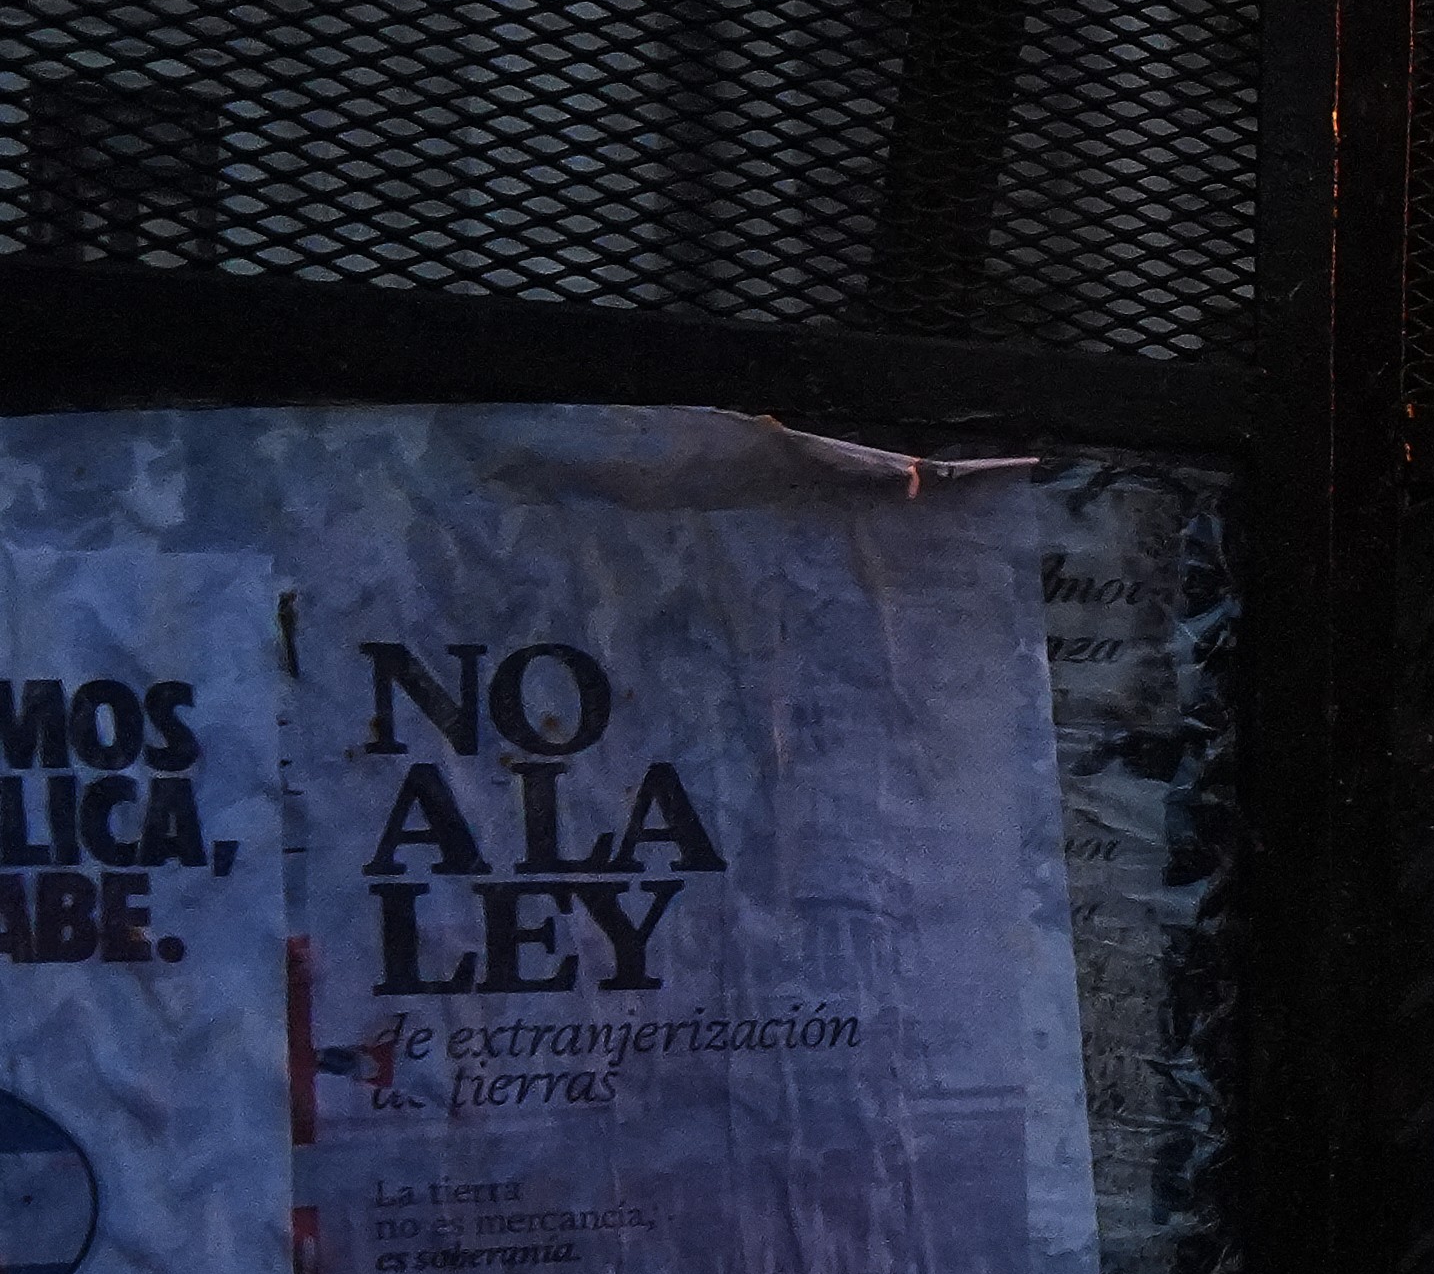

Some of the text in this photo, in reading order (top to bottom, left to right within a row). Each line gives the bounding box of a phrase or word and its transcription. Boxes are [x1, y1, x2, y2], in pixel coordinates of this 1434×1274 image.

[0, 679, 197, 771] MOS
[361, 642, 613, 756] NO
[363, 762, 728, 877] A LA
[374, 880, 684, 996] LEY
[447, 1003, 862, 1067] extranjerización
[451, 1060, 621, 1115] tierras
[375, 1175, 521, 1209] La tierra
